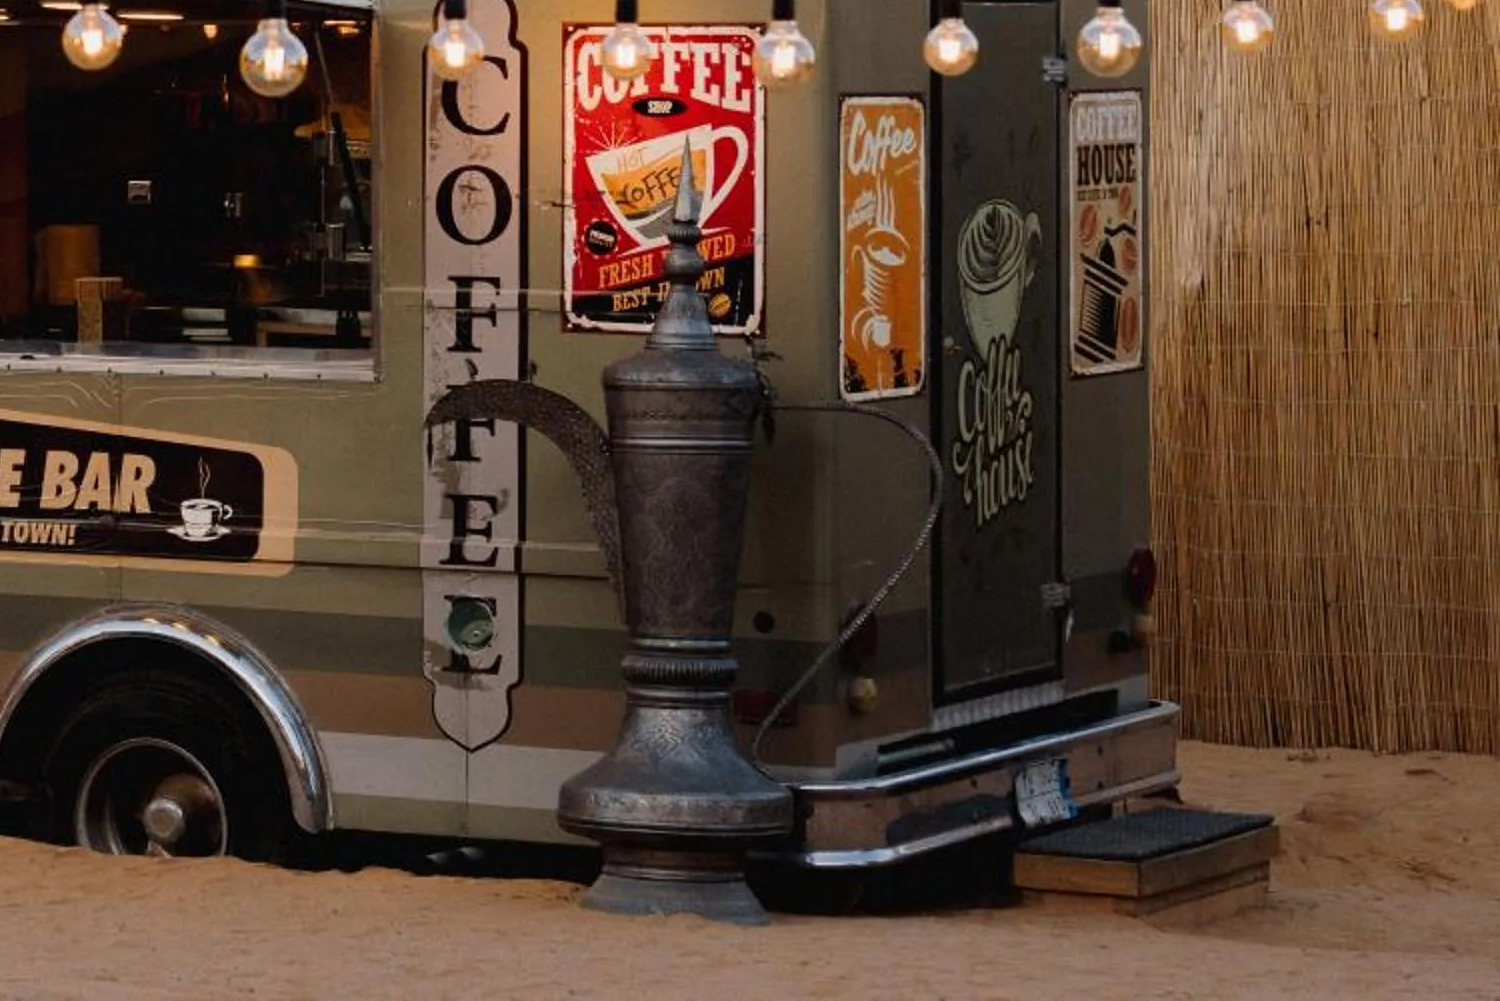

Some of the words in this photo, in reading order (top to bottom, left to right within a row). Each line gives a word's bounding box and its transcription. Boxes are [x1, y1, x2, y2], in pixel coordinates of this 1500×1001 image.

[847, 109, 917, 176] Coffee
[1076, 142, 1137, 186] HOUSE
[598, 253, 654, 289] FRESH
[612, 286, 651, 312] BEST
[39, 448, 157, 515] BAR
[1, 521, 77, 547] TOWN!
